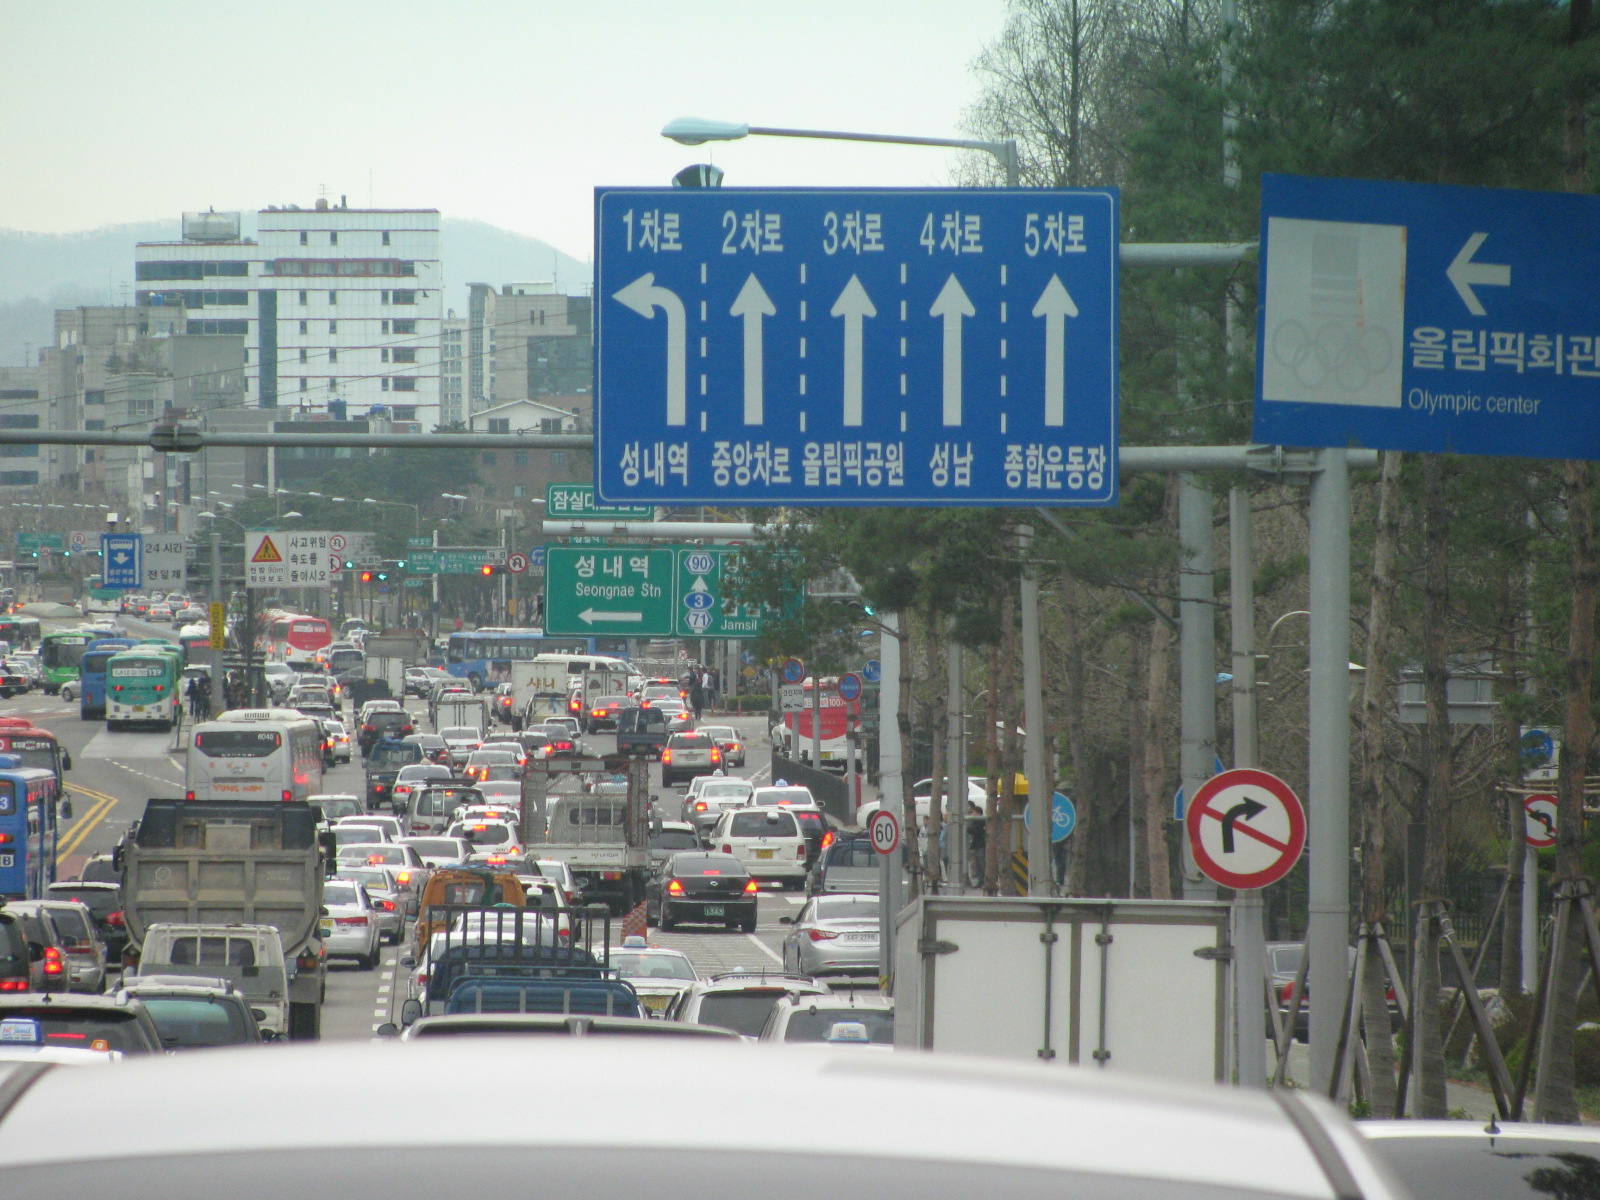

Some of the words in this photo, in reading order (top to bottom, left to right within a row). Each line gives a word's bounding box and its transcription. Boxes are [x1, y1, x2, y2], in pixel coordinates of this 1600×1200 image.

[623, 209, 682, 253] 1차로
[722, 210, 783, 255] 2차로
[823, 211, 884, 256] 3차로
[920, 211, 982, 256] 4차로
[1024, 211, 1086, 257] 5차로
[1409, 388, 1481, 415] Olympic
[1486, 394, 1540, 414] center
[620, 441, 688, 487] 성내역
[711, 441, 791, 486] 중앙차로
[802, 442, 904, 487] 올림픽공원
[929, 442, 974, 487] 성남
[1004, 444, 1106, 490] 종합운동장
[145, 543, 160, 553] 24
[163, 542, 182, 553] 시간
[290, 552, 318, 564] 속도를
[147, 569, 181, 580] 전일제
[574, 555, 648, 578] 성내역
[692, 556, 708, 570] 90
[291, 570, 326, 582] 줄이시오
[575, 582, 634, 600] Seongnae
[641, 583, 661, 598] Stn
[695, 595, 704, 608] 3
[692, 613, 707, 627] 71
[721, 620, 757, 631] Jamsil
[526, 677, 555, 688] 샤니
[875, 823, 893, 843] 60
